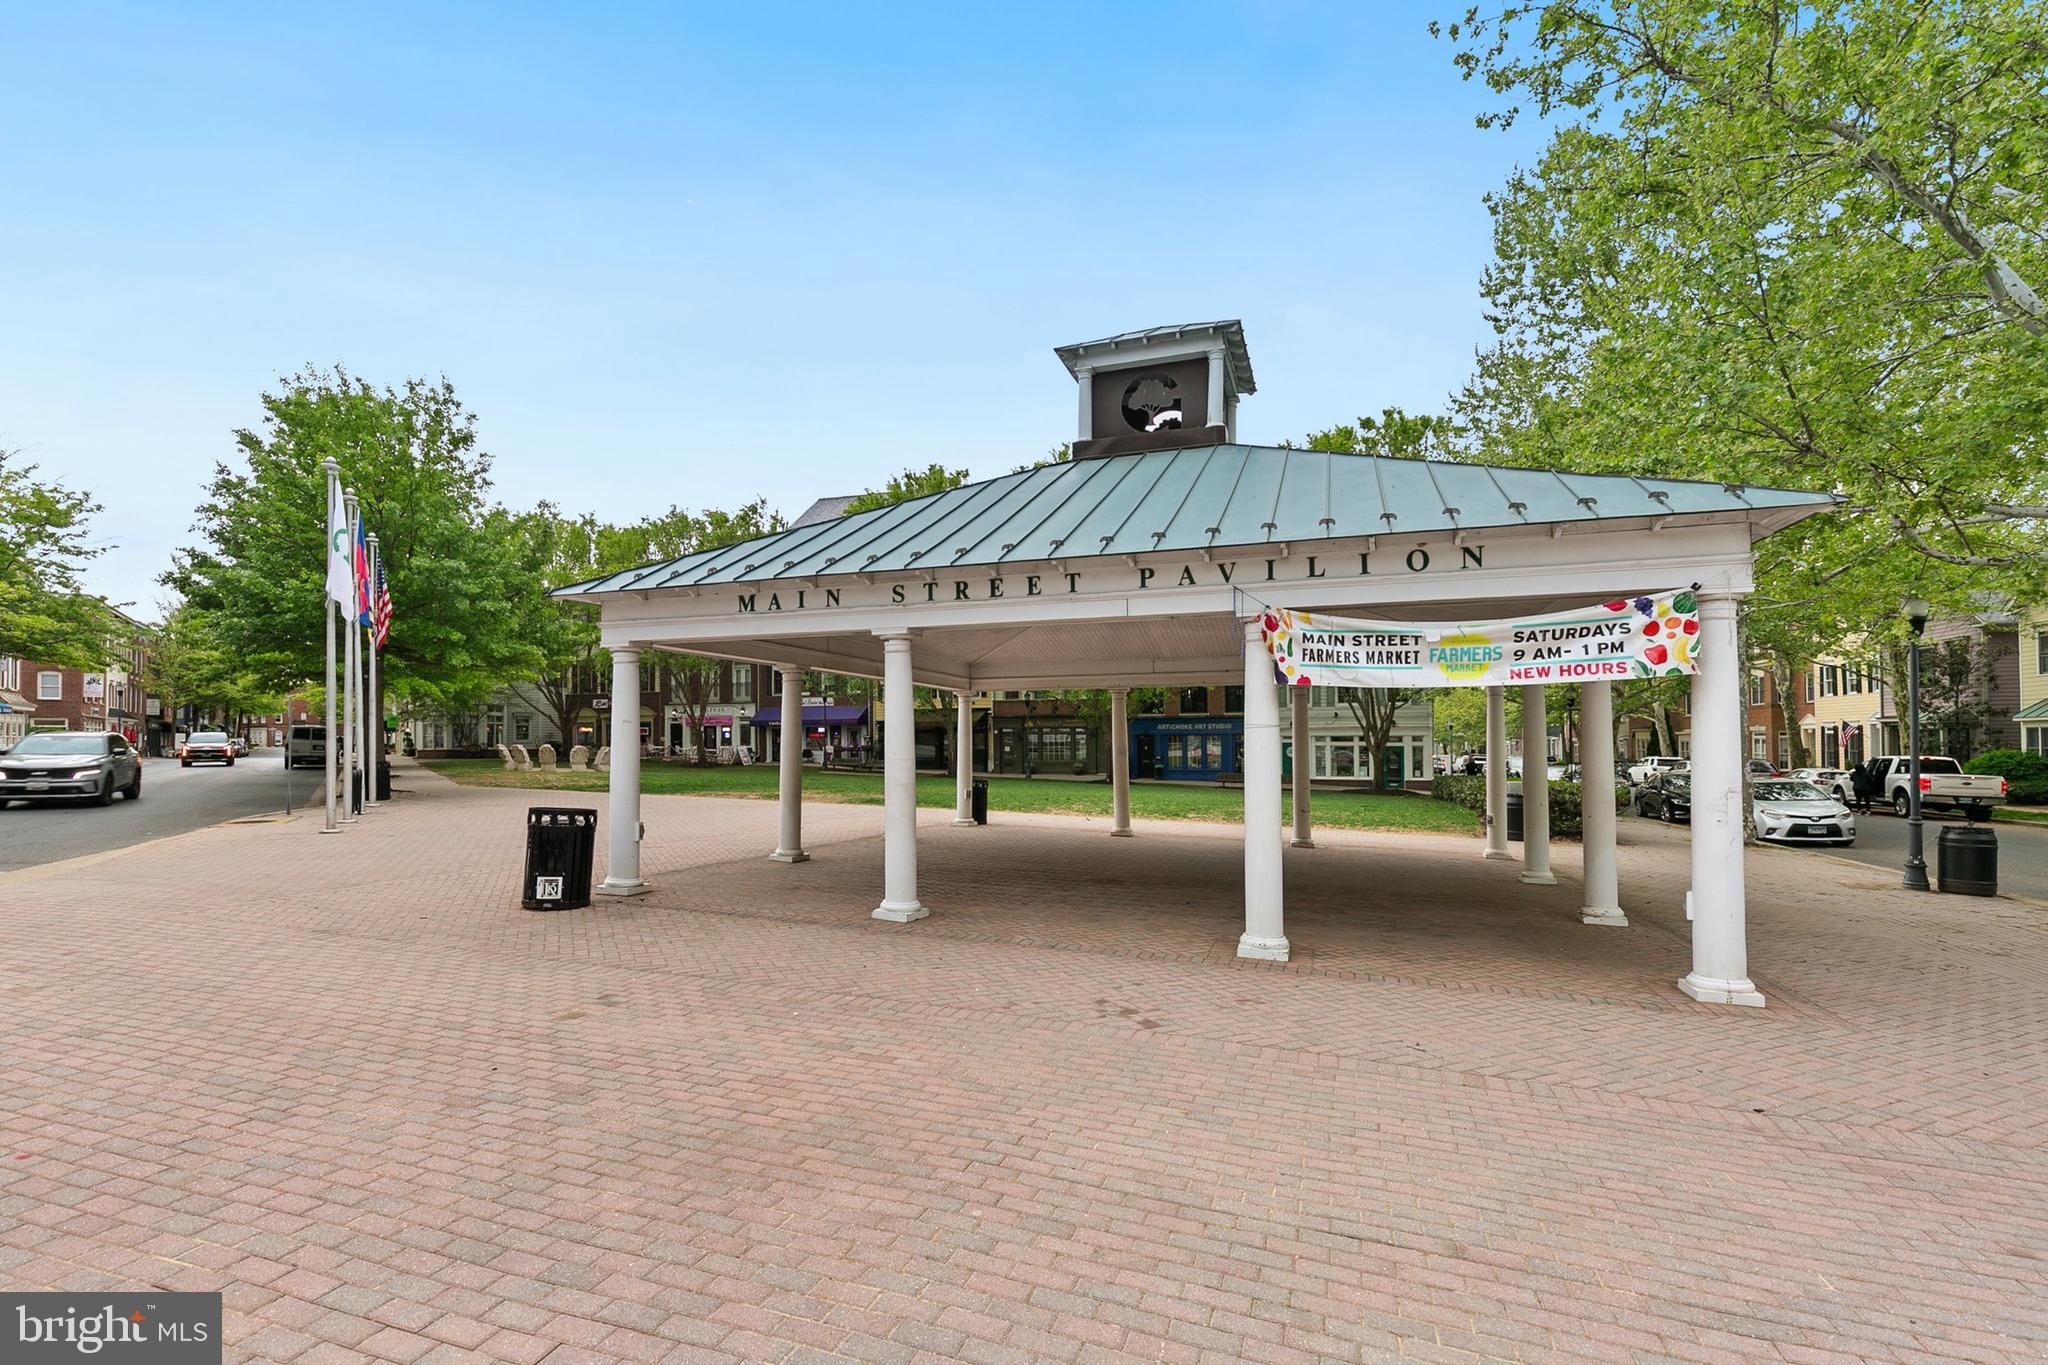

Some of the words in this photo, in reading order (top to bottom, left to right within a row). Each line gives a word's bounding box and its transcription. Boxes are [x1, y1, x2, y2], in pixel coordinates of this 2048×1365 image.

[738, 588, 841, 613] MAIN
[892, 572, 1081, 603] STREET
[1138, 545, 1484, 588] PAVILION
[1302, 632, 1345, 646] MAIN
[1352, 635, 1422, 646] STREET
[1513, 622, 1632, 643] SATURDAYS
[1302, 648, 1360, 664] FARMERS
[1366, 650, 1420, 664] MARKET
[1429, 646, 1503, 663] FARMERS
[1513, 649, 1525, 661] 9
[1582, 644, 1589, 655] 1
[1597, 641, 1624, 654] PM
[1446, 663, 1483, 672] MARKET
[1510, 666, 1551, 679] NEW
[1559, 662, 1628, 677] HOURS
